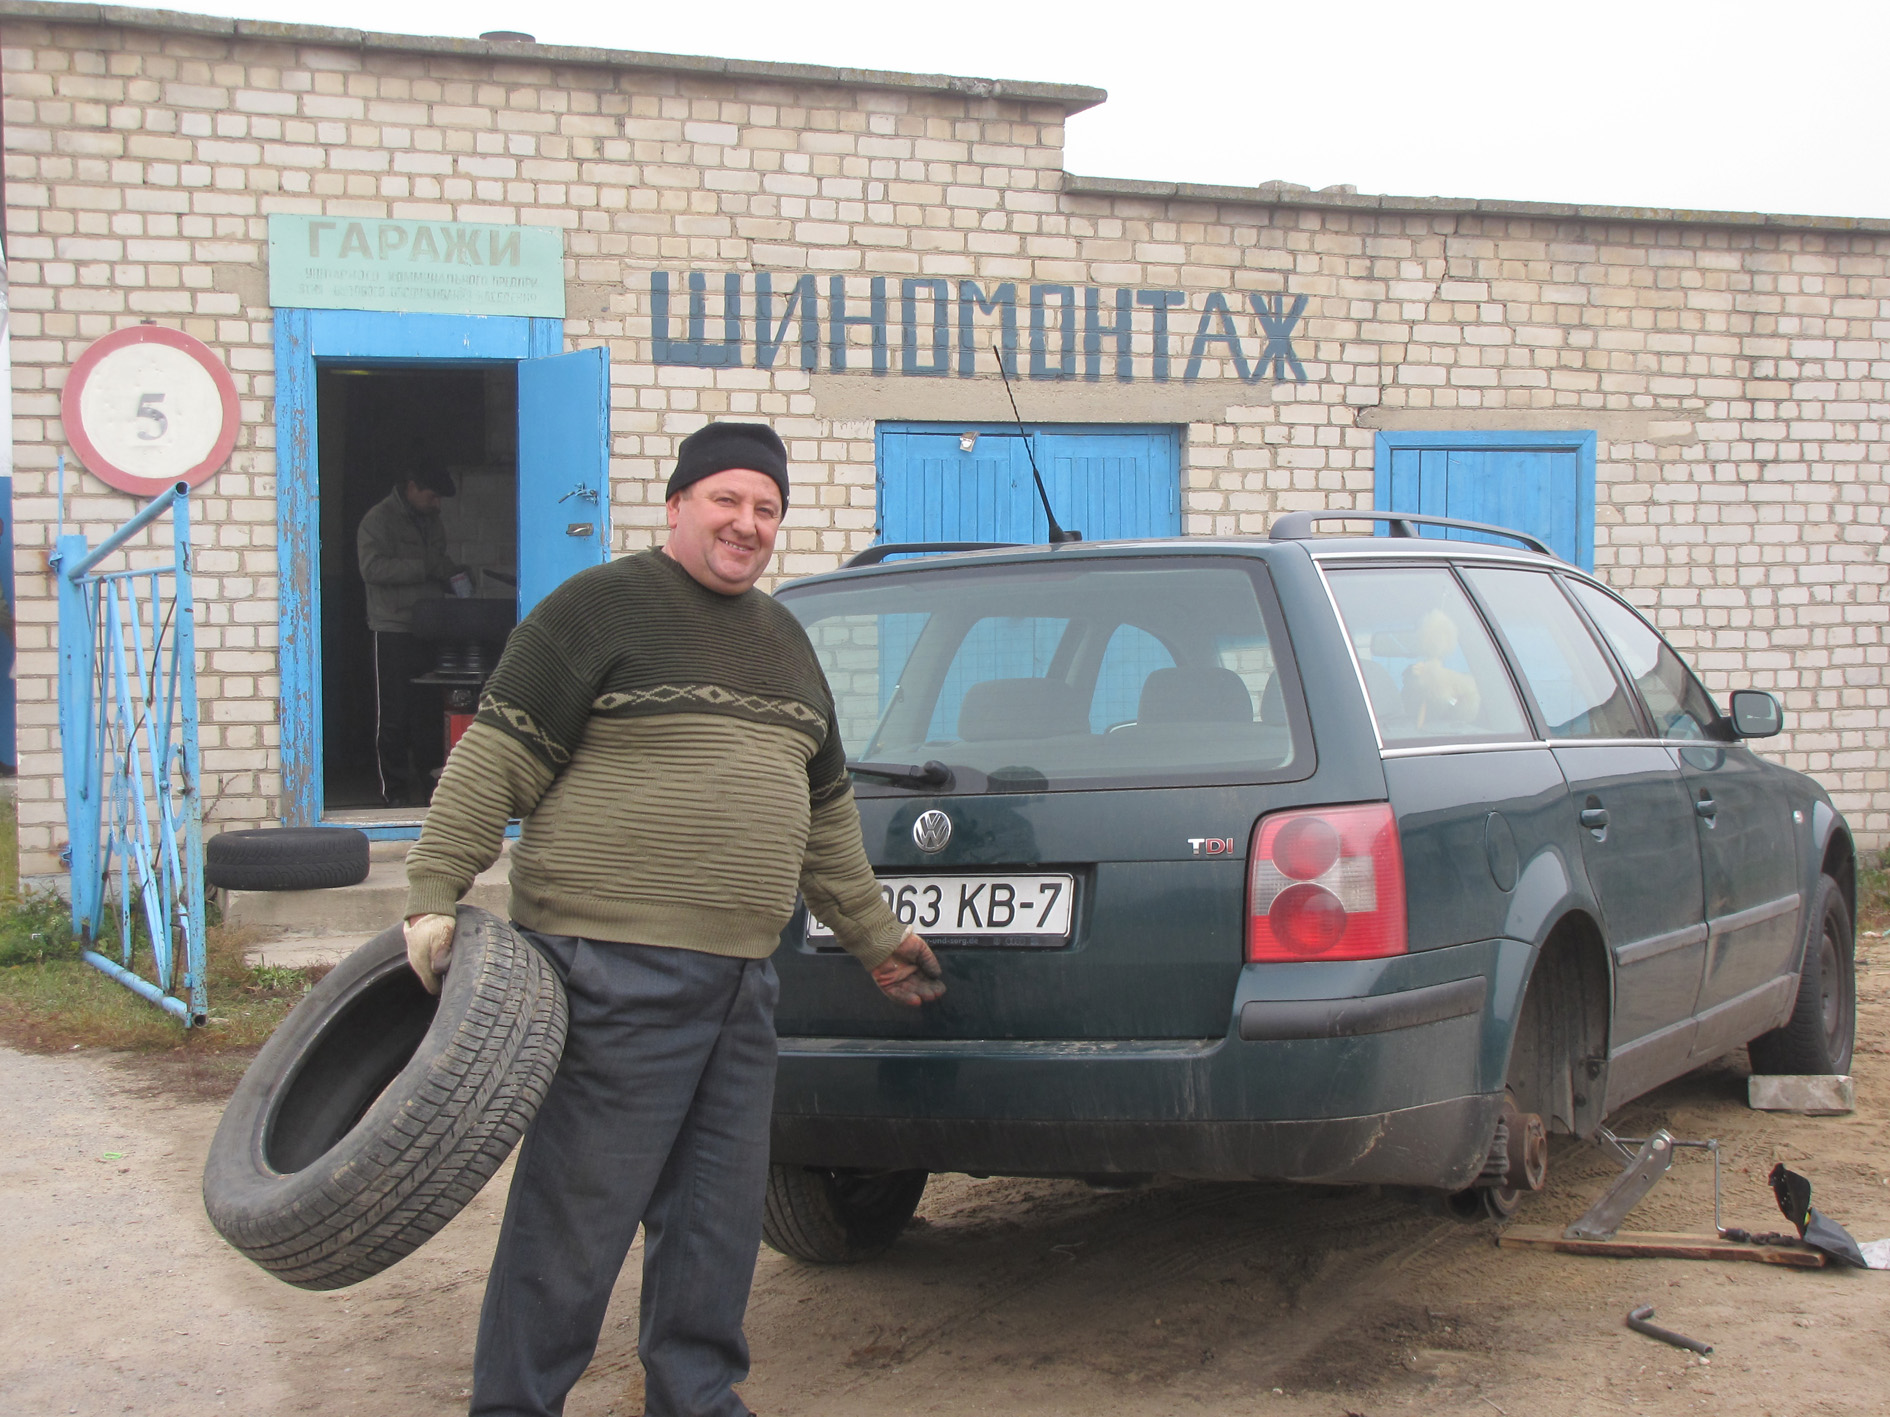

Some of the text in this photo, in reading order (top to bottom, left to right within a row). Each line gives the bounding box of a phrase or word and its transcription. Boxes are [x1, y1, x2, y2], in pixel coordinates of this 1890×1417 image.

[308, 221, 521, 267] ГАРАЖИ
[650, 271, 1309, 385] ШИНОМОНТАЖ
[136, 393, 169, 441] 5
[1187, 837, 1234, 855] TDI
[957, 883, 1063, 928] KB-7
